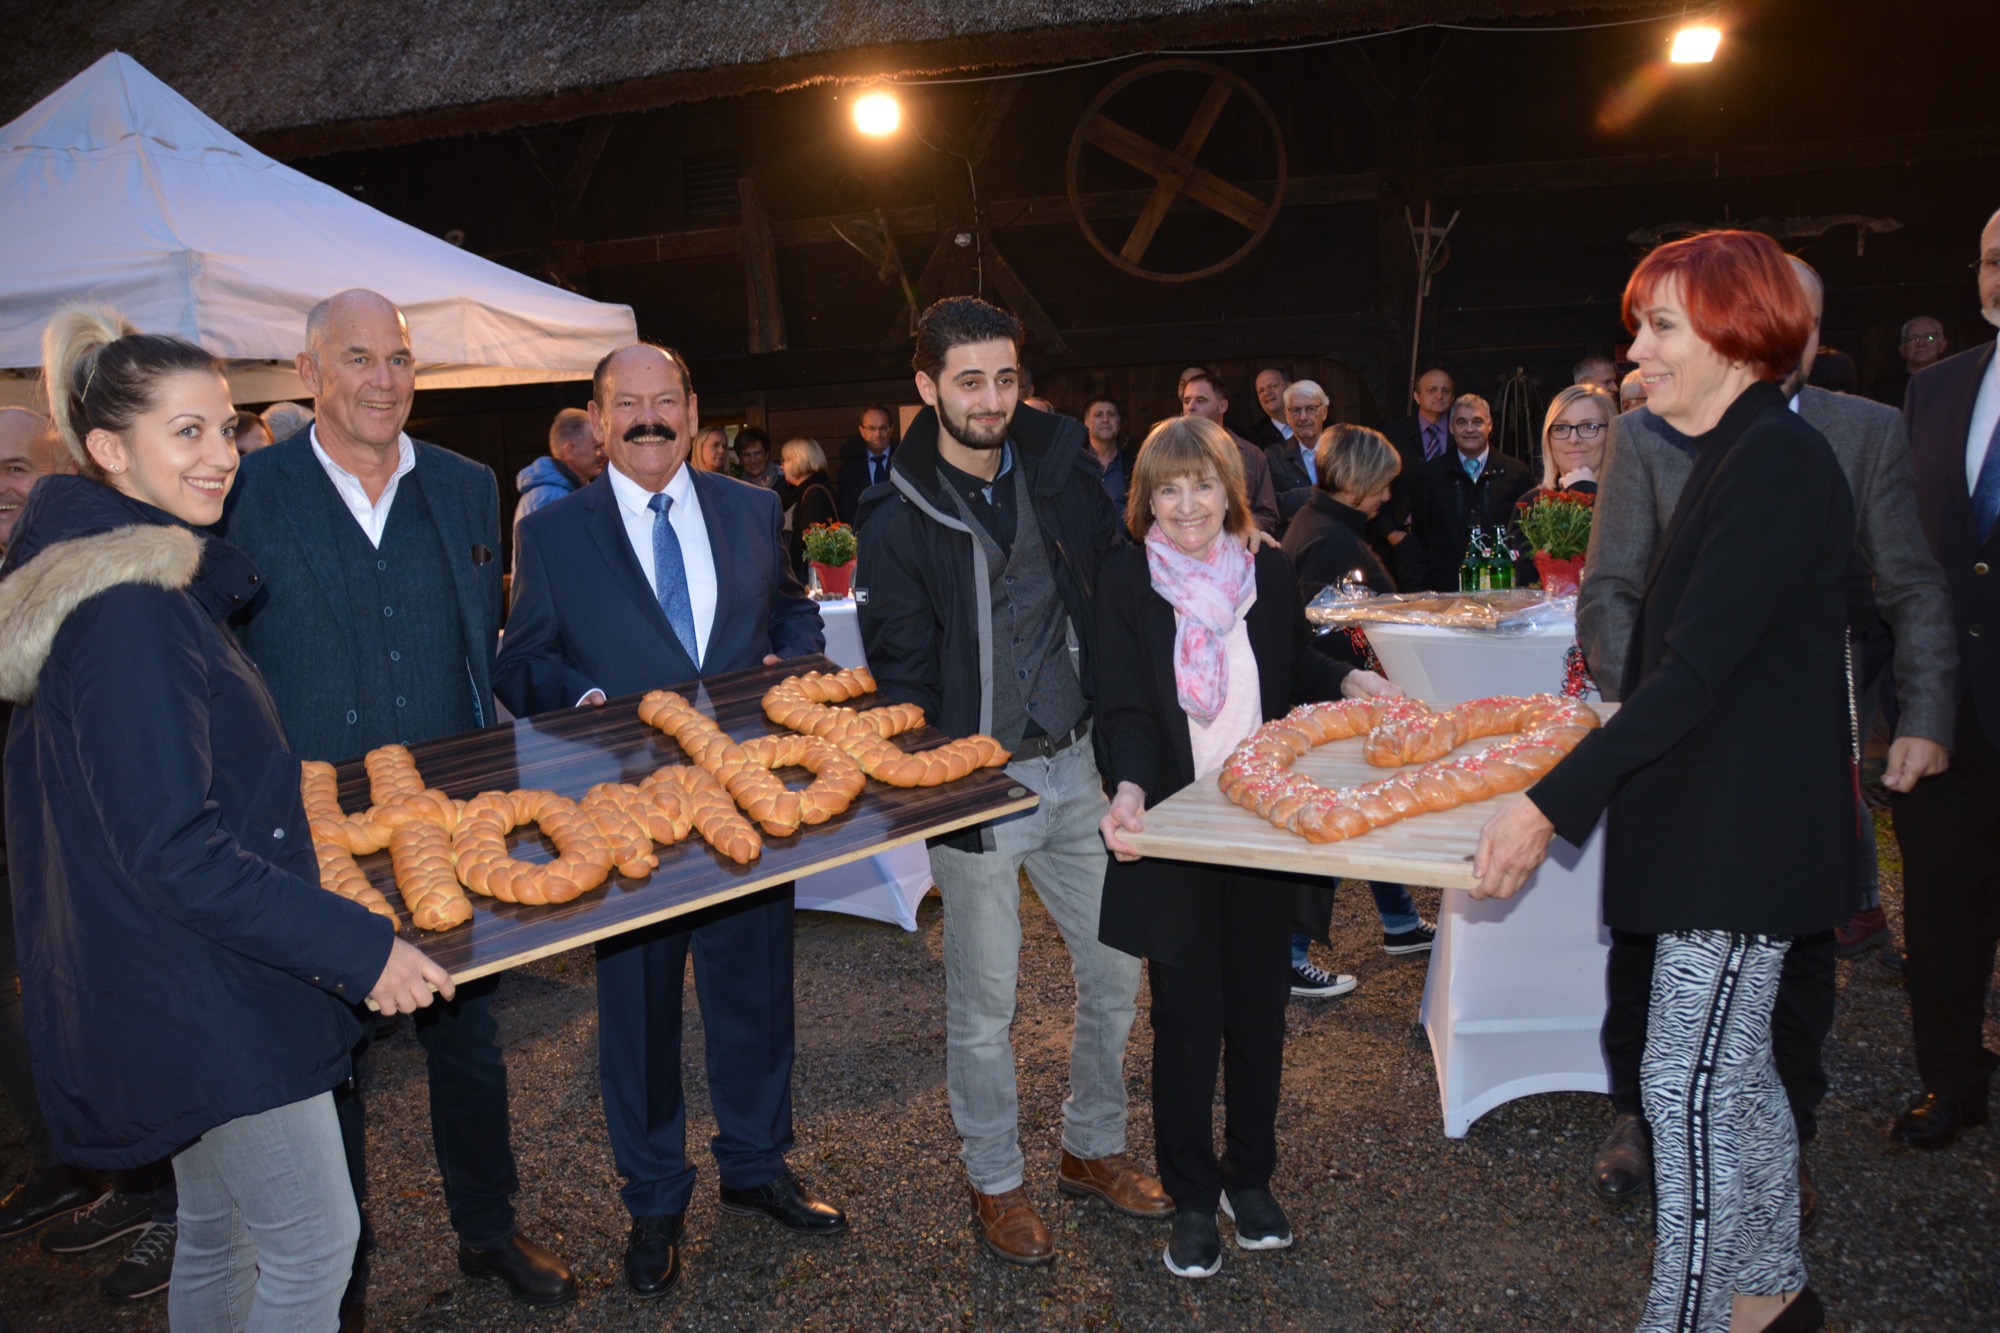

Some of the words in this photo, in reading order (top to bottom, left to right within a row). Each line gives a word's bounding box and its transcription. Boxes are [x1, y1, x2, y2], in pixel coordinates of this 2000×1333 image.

[1697, 1073, 1708, 1086] THE
[1694, 1086, 1704, 1111] FUTURE
[1694, 1219, 1706, 1238] THE
[1691, 1239, 1704, 1275] FUTURE
